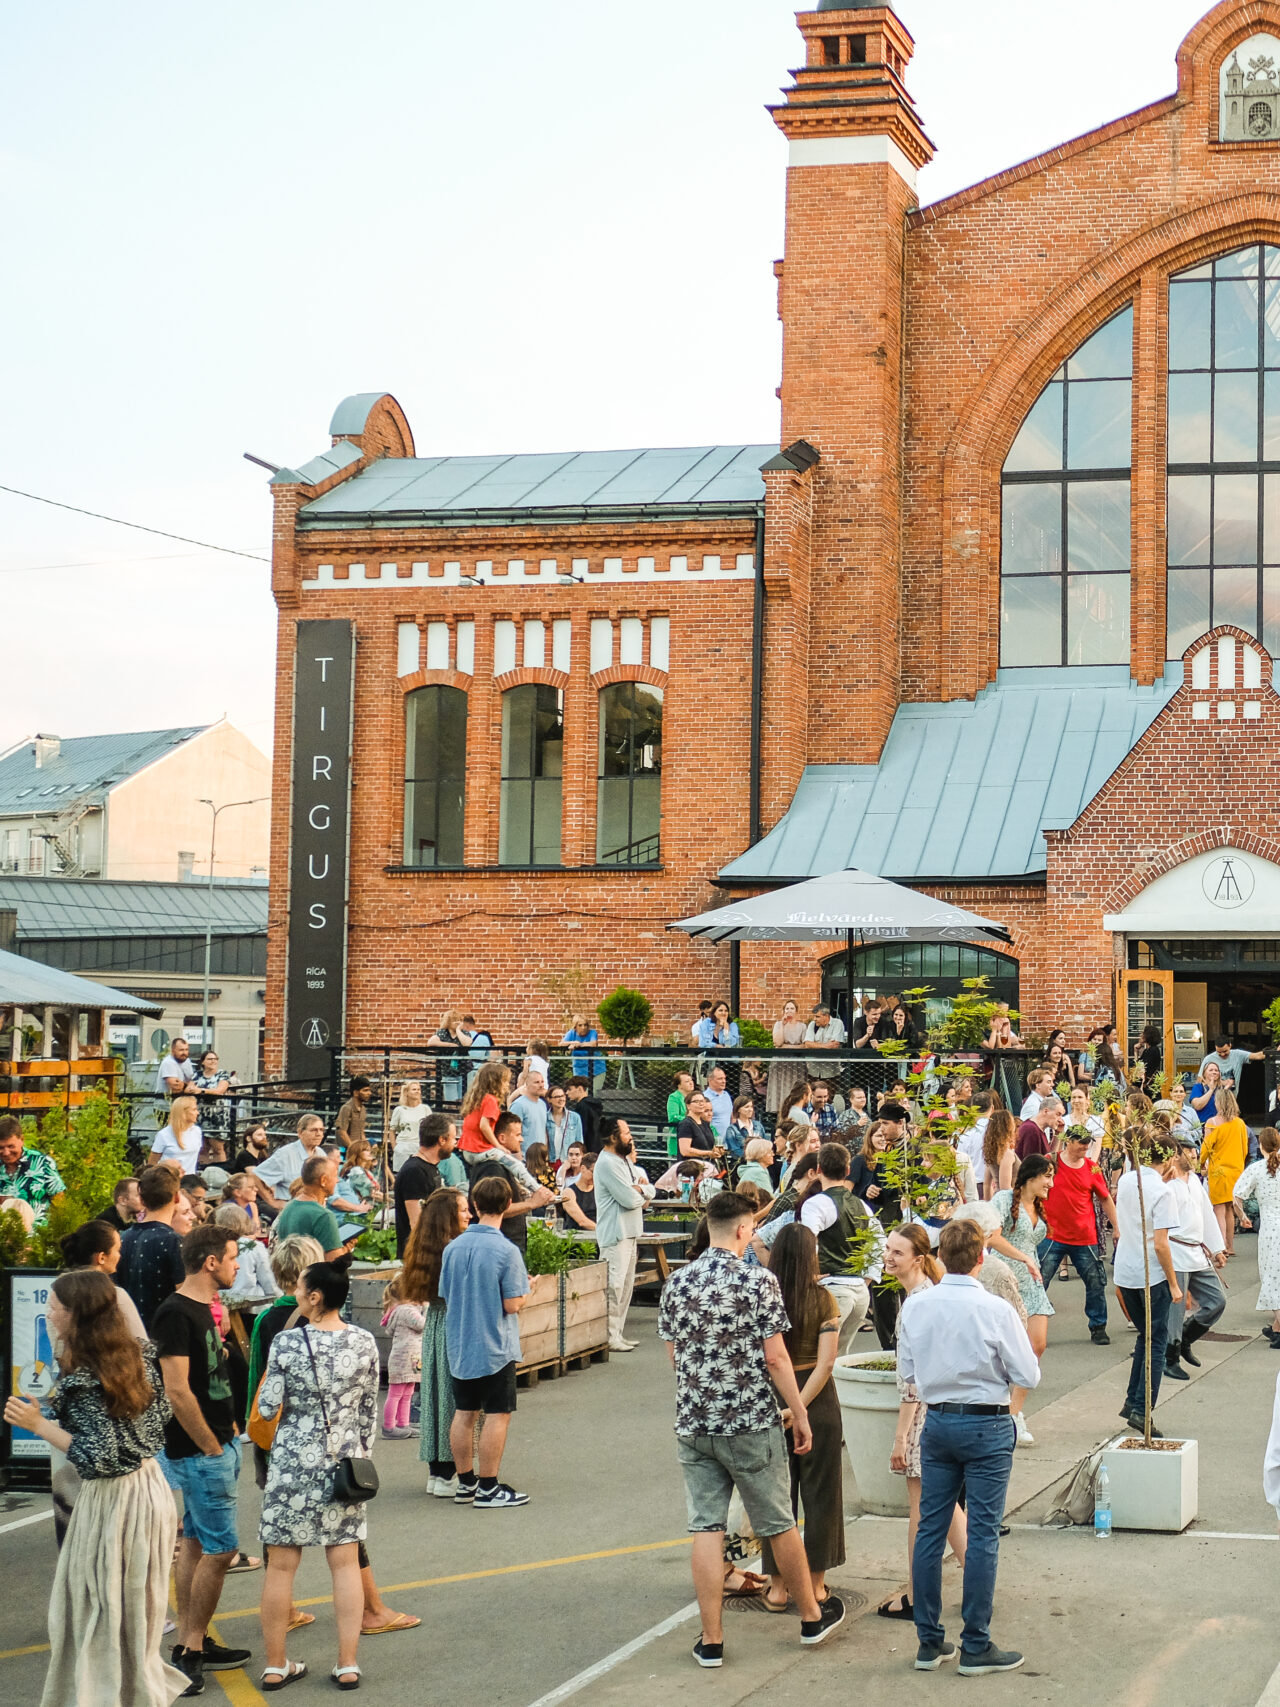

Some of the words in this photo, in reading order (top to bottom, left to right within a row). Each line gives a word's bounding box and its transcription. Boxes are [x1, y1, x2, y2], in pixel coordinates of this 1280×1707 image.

[308, 657, 334, 929] TIRGUS
[307, 980, 325, 989] 1893
[33, 1289, 48, 1304] 18
[32, 1372, 39, 1383] 2
